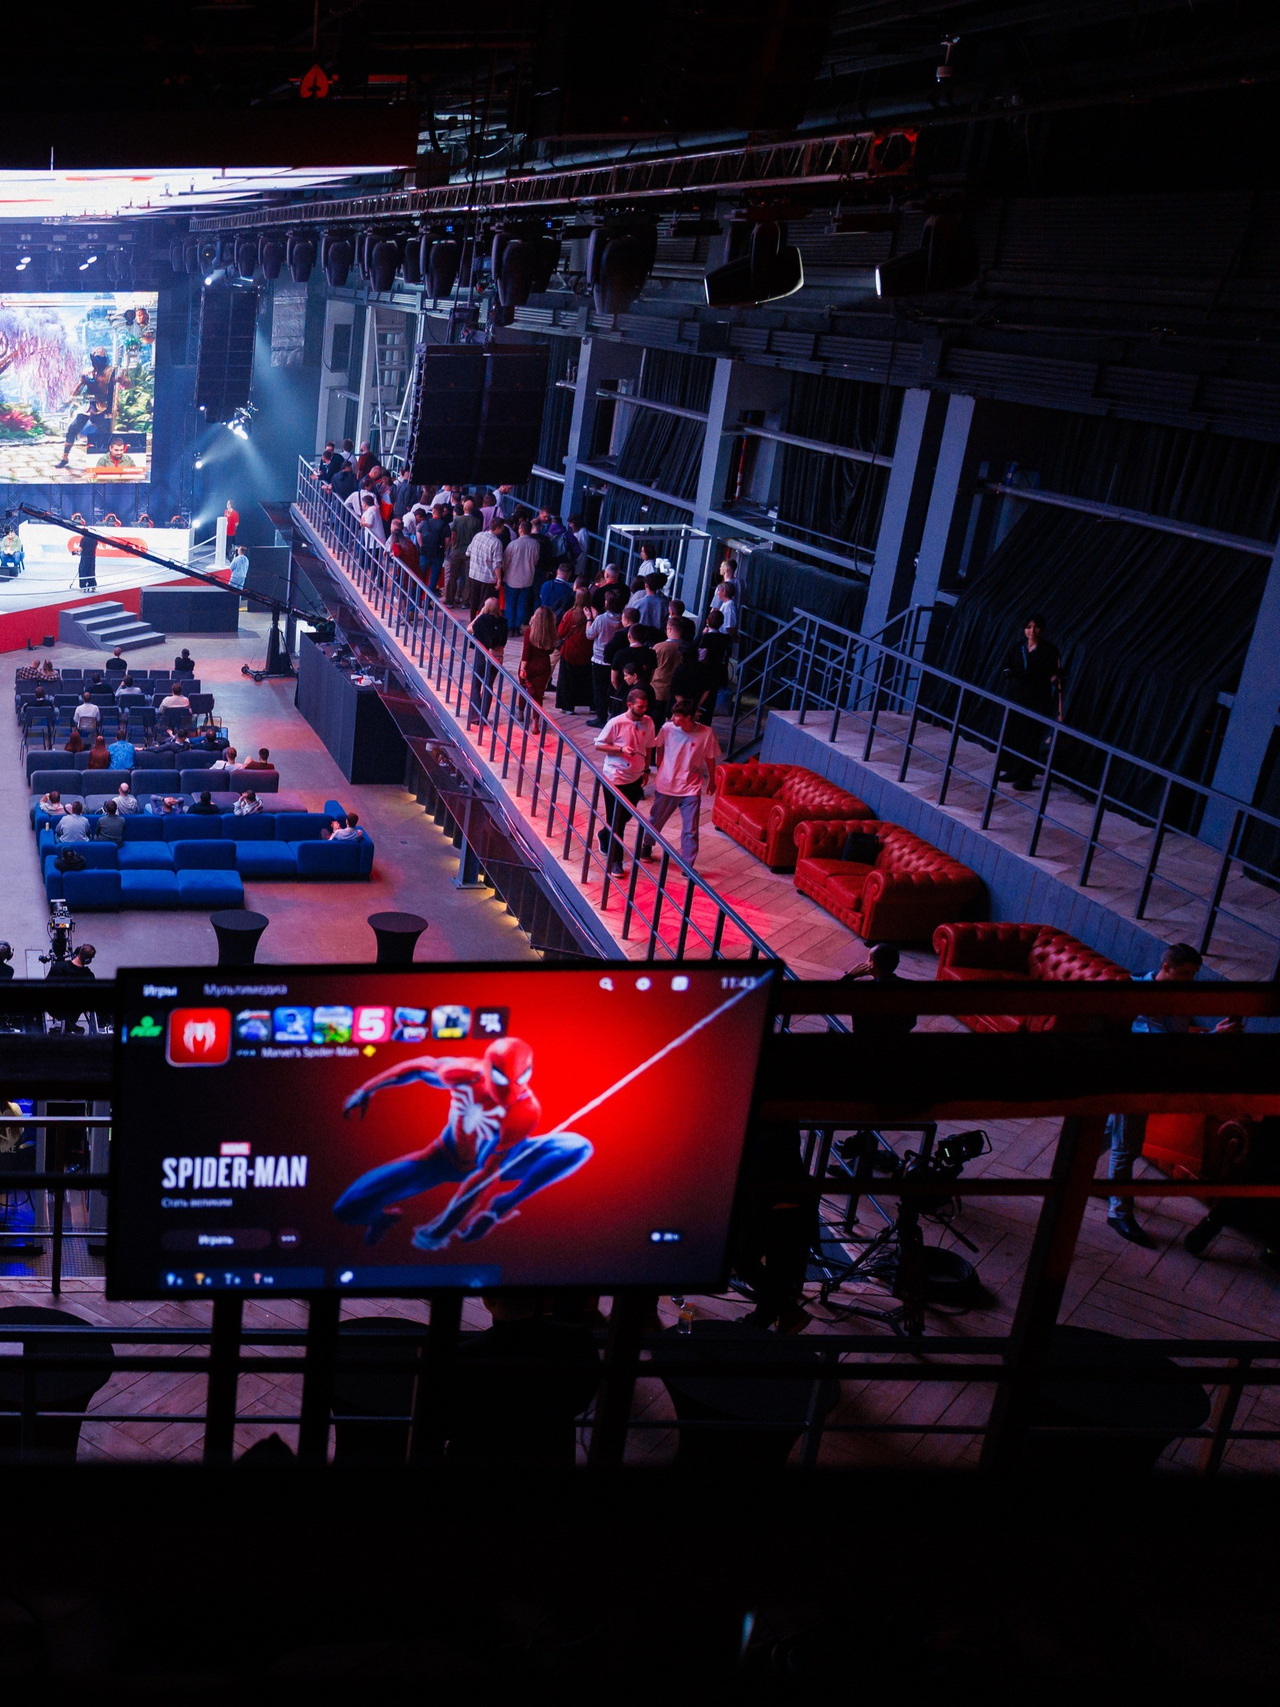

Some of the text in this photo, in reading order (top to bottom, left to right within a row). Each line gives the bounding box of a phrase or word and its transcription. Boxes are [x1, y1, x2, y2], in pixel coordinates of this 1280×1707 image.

[143, 983, 288, 998] Игры Мультимедиа
[721, 976, 758, 990] 11:43
[358, 1008, 386, 1041] 5
[261, 1046, 301, 1058] Marvel's
[302, 1046, 359, 1059] Spider-Man
[161, 1155, 308, 1190] SPIDER-MAN
